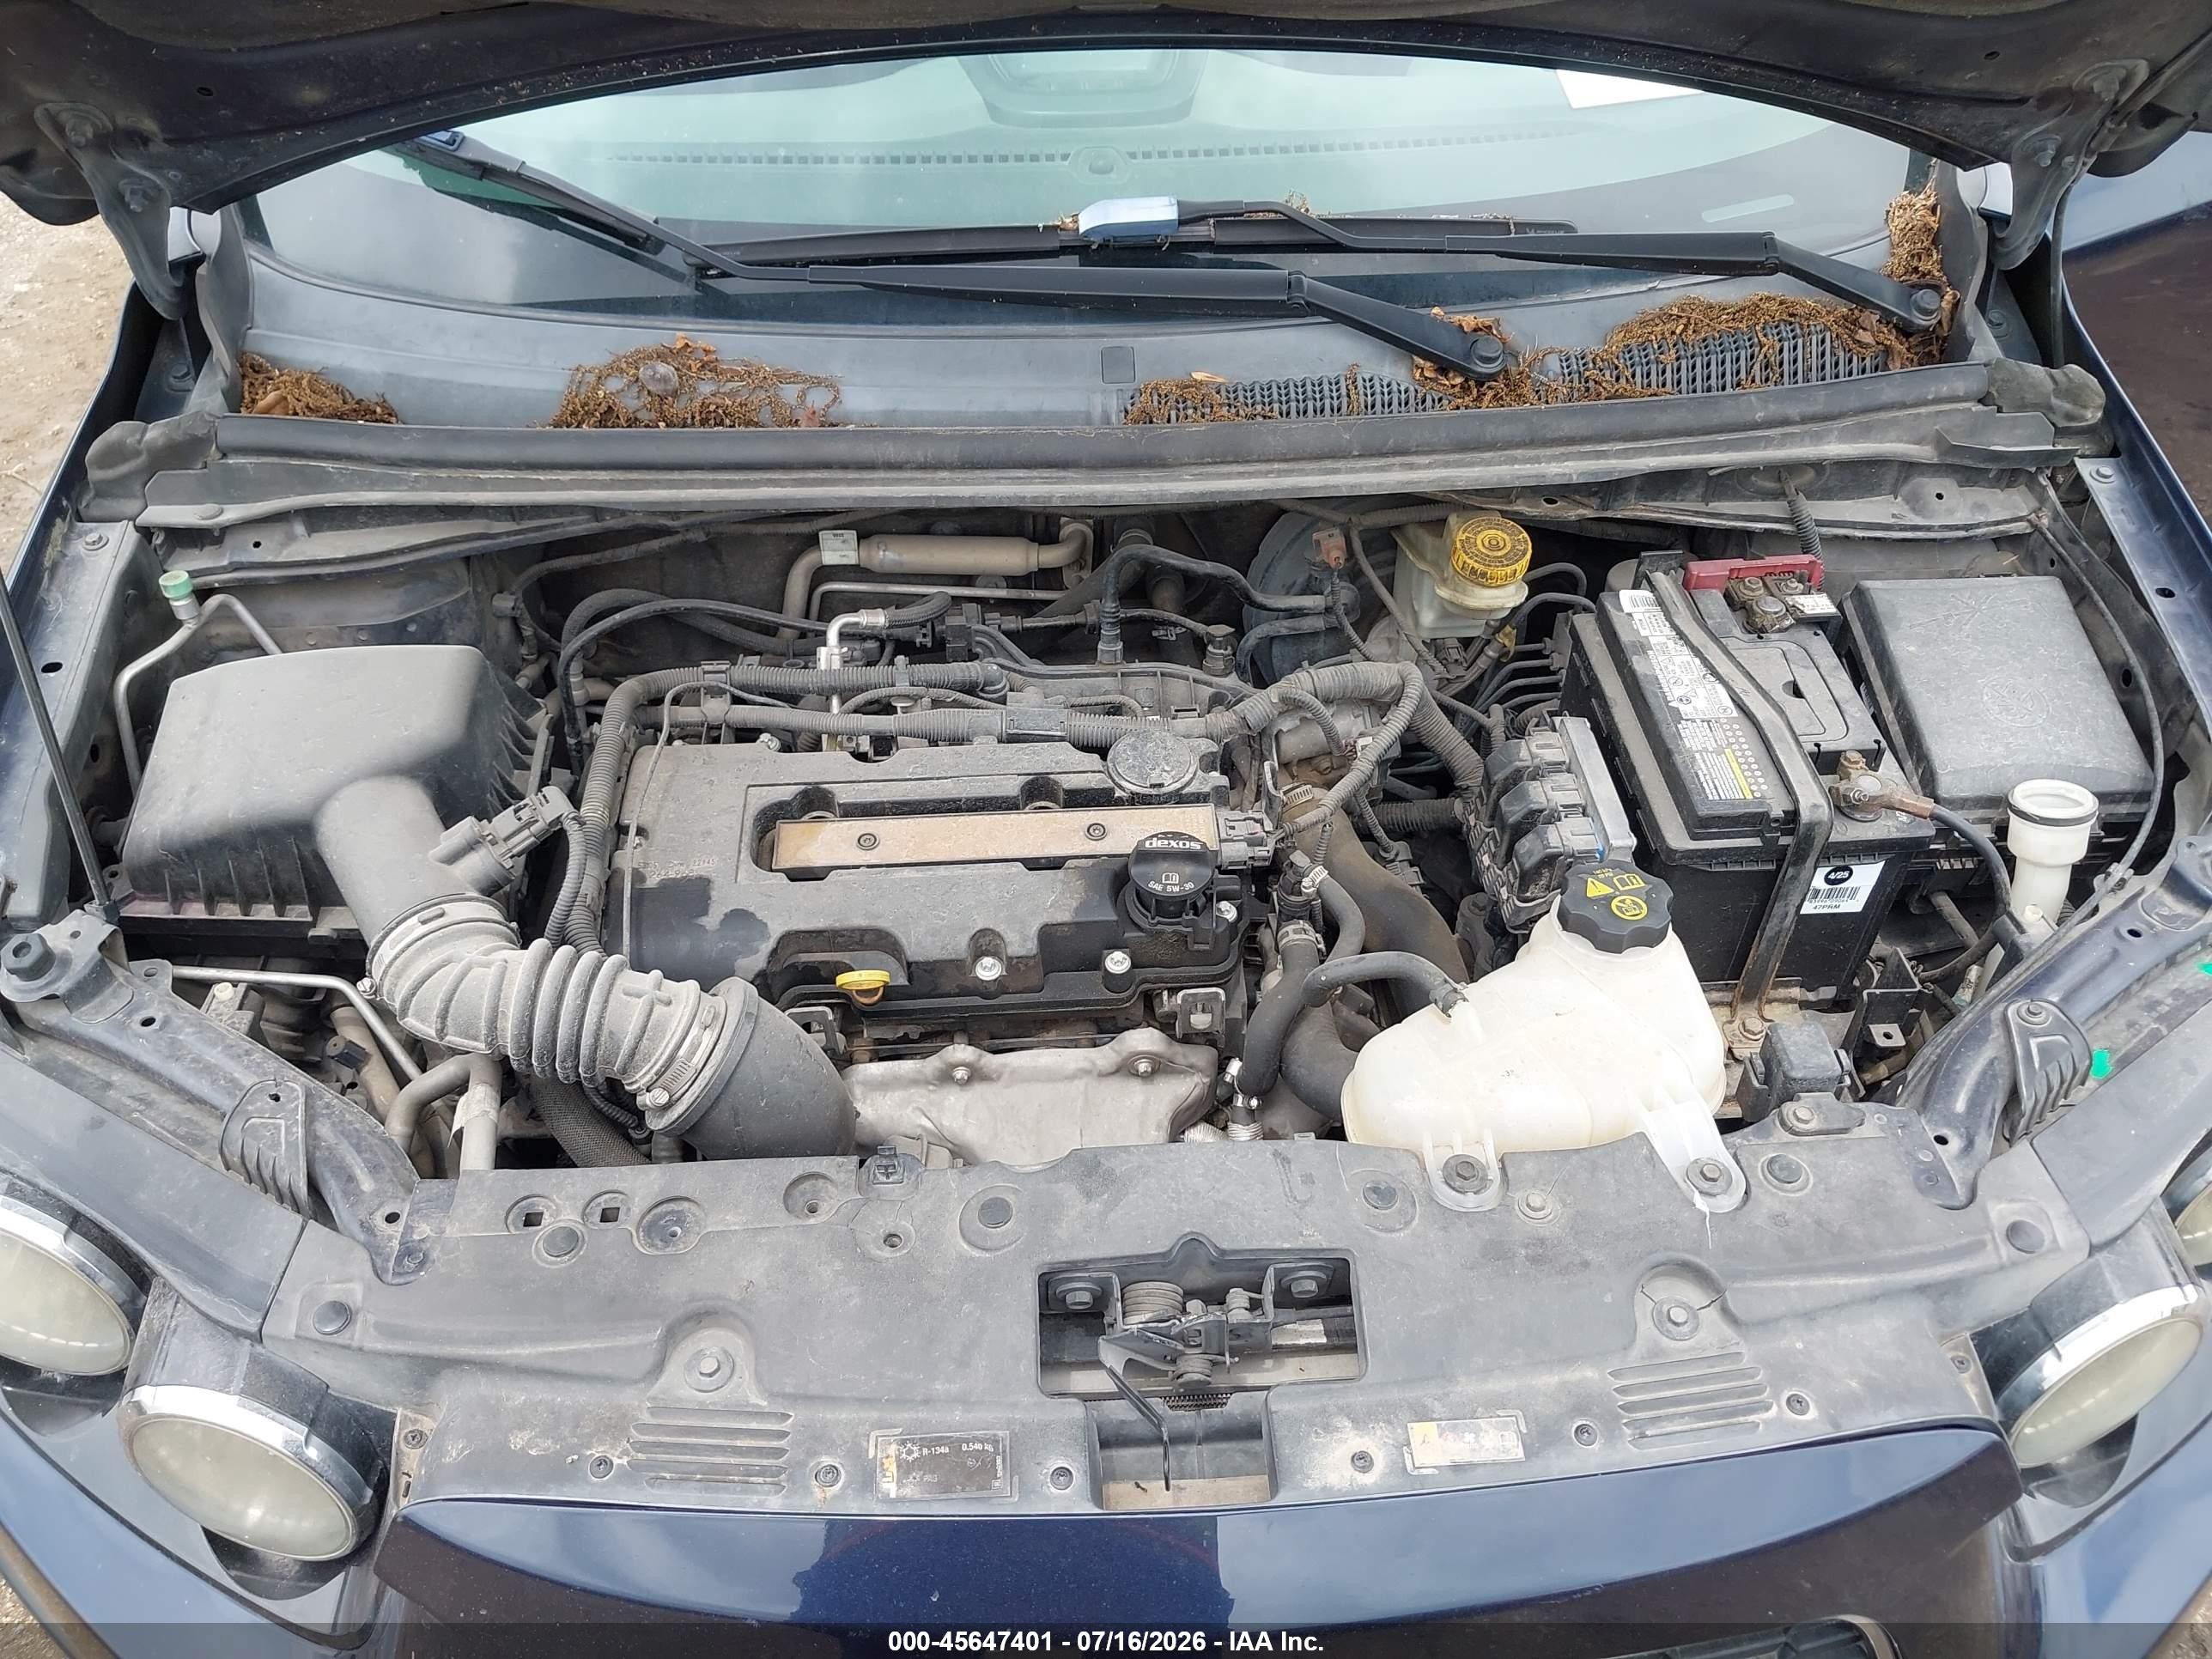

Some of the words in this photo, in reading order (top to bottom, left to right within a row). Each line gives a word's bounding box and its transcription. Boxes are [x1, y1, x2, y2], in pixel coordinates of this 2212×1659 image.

[1145, 837, 1202, 849] dexos
[1827, 871, 1850, 879] 4/25
[1147, 880, 1164, 891] SAE
[1166, 881, 1195, 892] 5W-30
[922, 1446, 950, 1456] R-134a
